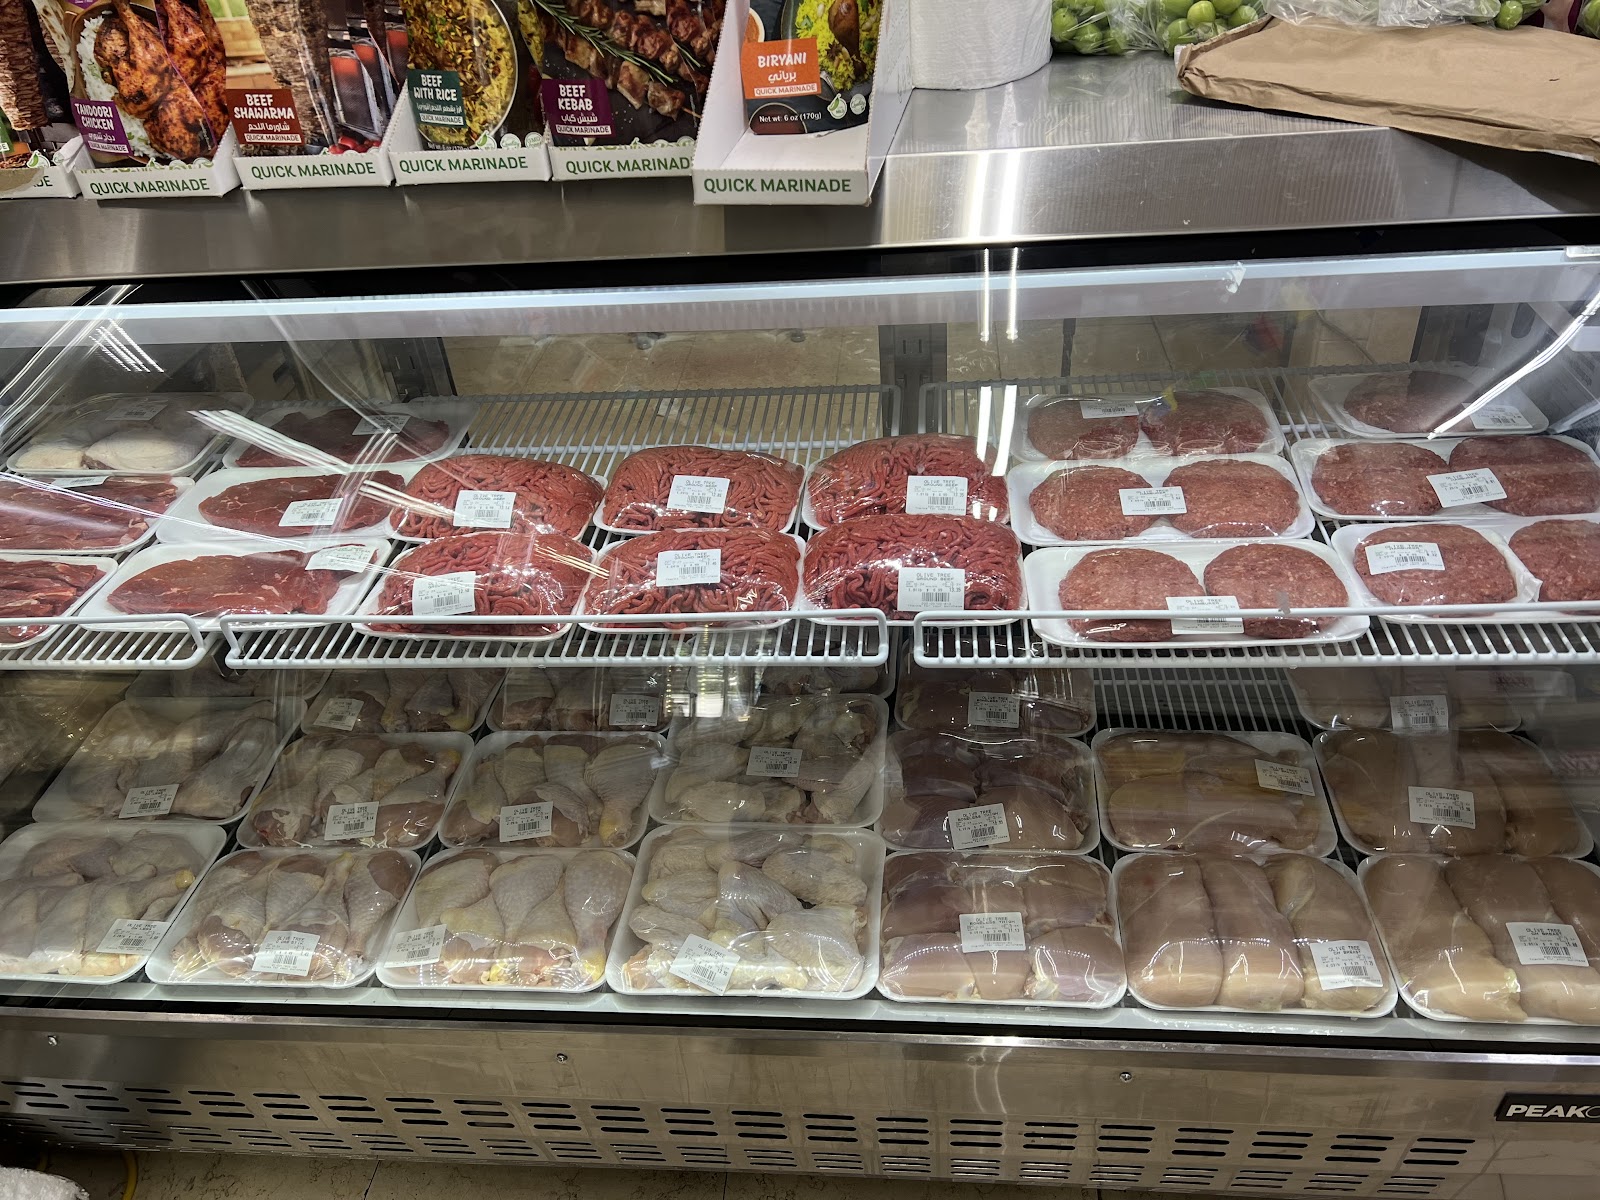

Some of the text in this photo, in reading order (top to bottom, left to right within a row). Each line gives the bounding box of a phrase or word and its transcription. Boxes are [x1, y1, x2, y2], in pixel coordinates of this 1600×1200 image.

[757, 52, 807, 68] BIRYANI
[420, 74, 442, 87] BEEF
[767, 70, 797, 84] برياني
[413, 86, 458, 101] WITH RICE
[558, 84, 586, 97] BEEF
[756, 84, 816, 95] QUICK MARINADE
[244, 93, 274, 106] BEEF
[557, 98, 593, 111] KEBAB
[74, 103, 113, 118] TANDOORI
[233, 107, 295, 120] SHAWARMA
[800, 112, 822, 121] (170g)
[81, 116, 115, 131] CHICKEN
[561, 112, 598, 125] شيش كباب
[265, 121, 290, 132] شاورما
[557, 125, 610, 133] QUICK MARINADE
[246, 134, 300, 142] QUICK MARINADE
[251, 162, 376, 180] QUICK MARINADE
[399, 156, 529, 174] QUICK MARINADE
[566, 157, 693, 174] QUICK MARINAD
[89, 178, 210, 196] QUICK MARINADE
[703, 178, 852, 194] QUICK MARINADE
